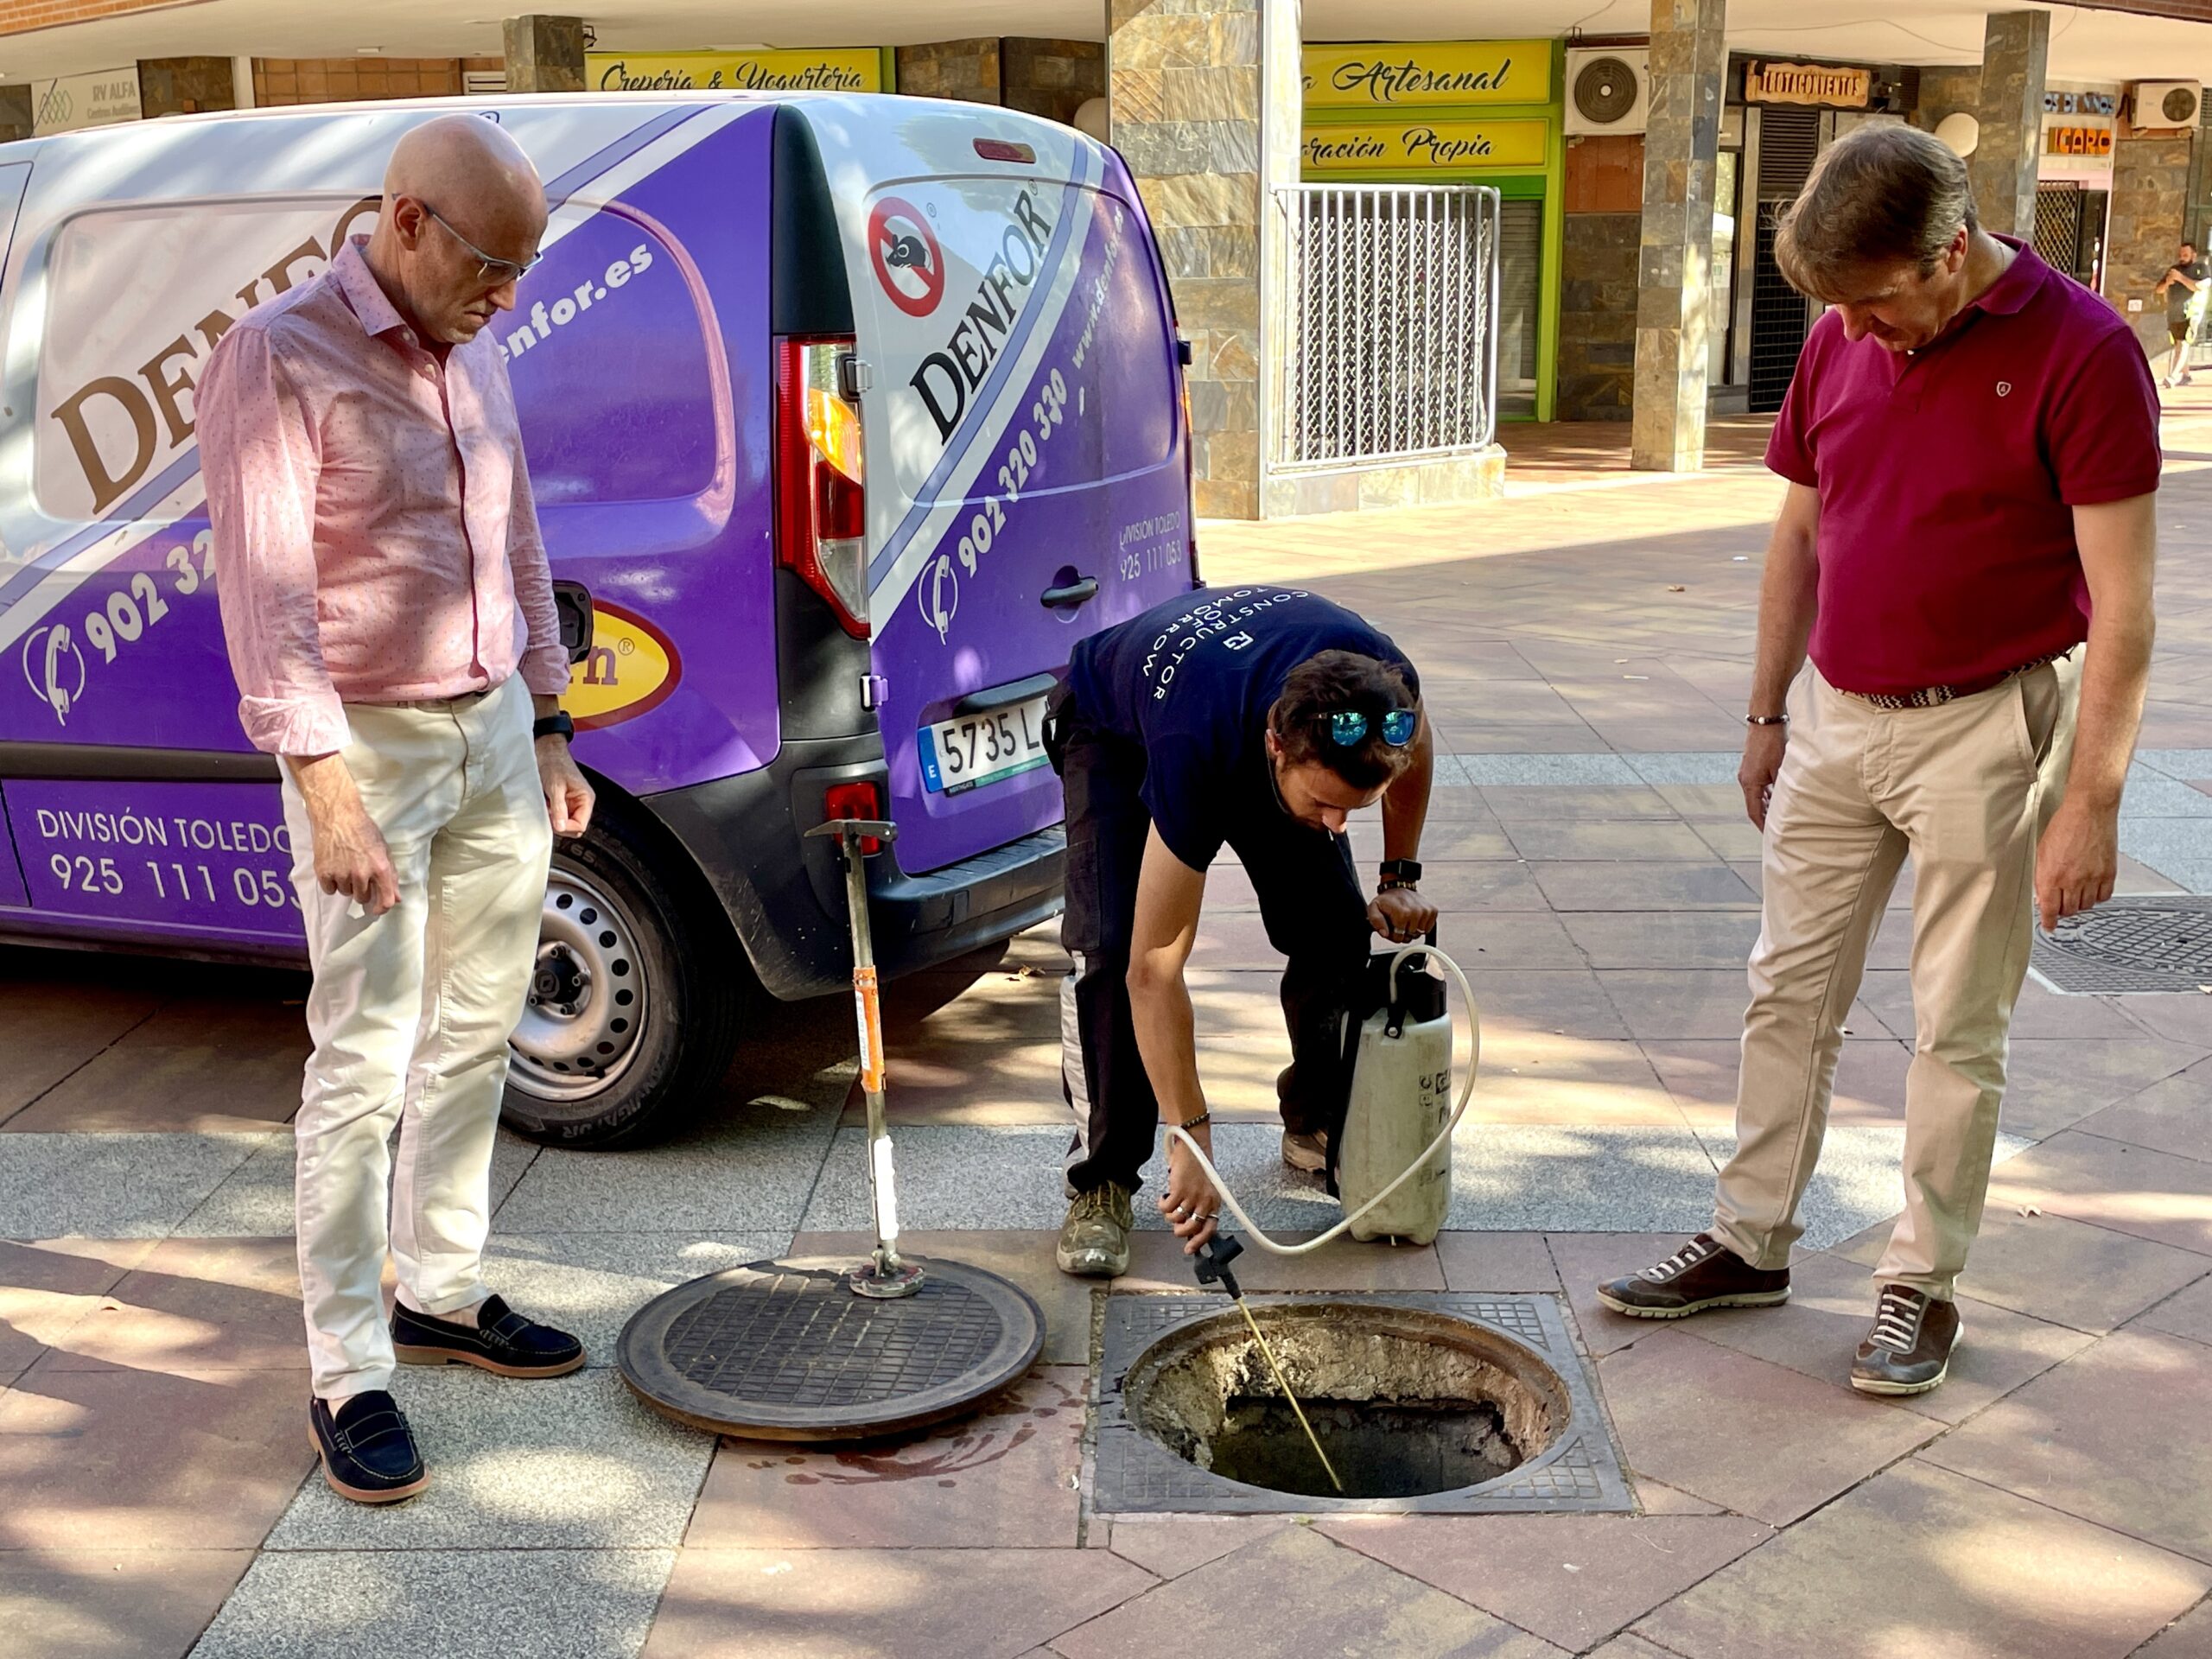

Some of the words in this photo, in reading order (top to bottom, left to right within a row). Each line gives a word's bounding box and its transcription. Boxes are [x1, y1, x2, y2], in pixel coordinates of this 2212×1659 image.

[92, 84, 107, 102] RV
[110, 80, 136, 100] ALFA
[709, 71, 723, 89] &
[1332, 58, 1511, 102] Artesanal
[1402, 128, 1494, 164] Propia
[910, 189, 1052, 446] DENFOR
[958, 496, 1007, 579] 902
[998, 429, 1037, 503] 320
[1033, 368, 1068, 441] 330
[1120, 553, 1141, 582] 925
[1147, 545, 1163, 573] 111
[1166, 538, 1181, 567] 053
[85, 573, 169, 665] 902
[1154, 591, 1308, 701] CONSTRUCTOR
[943, 713, 1016, 774] 5735
[927, 764, 937, 779] E
[36, 806, 168, 847] DIVISIÓN
[50, 854, 124, 895] 925
[147, 861, 216, 902] 111
